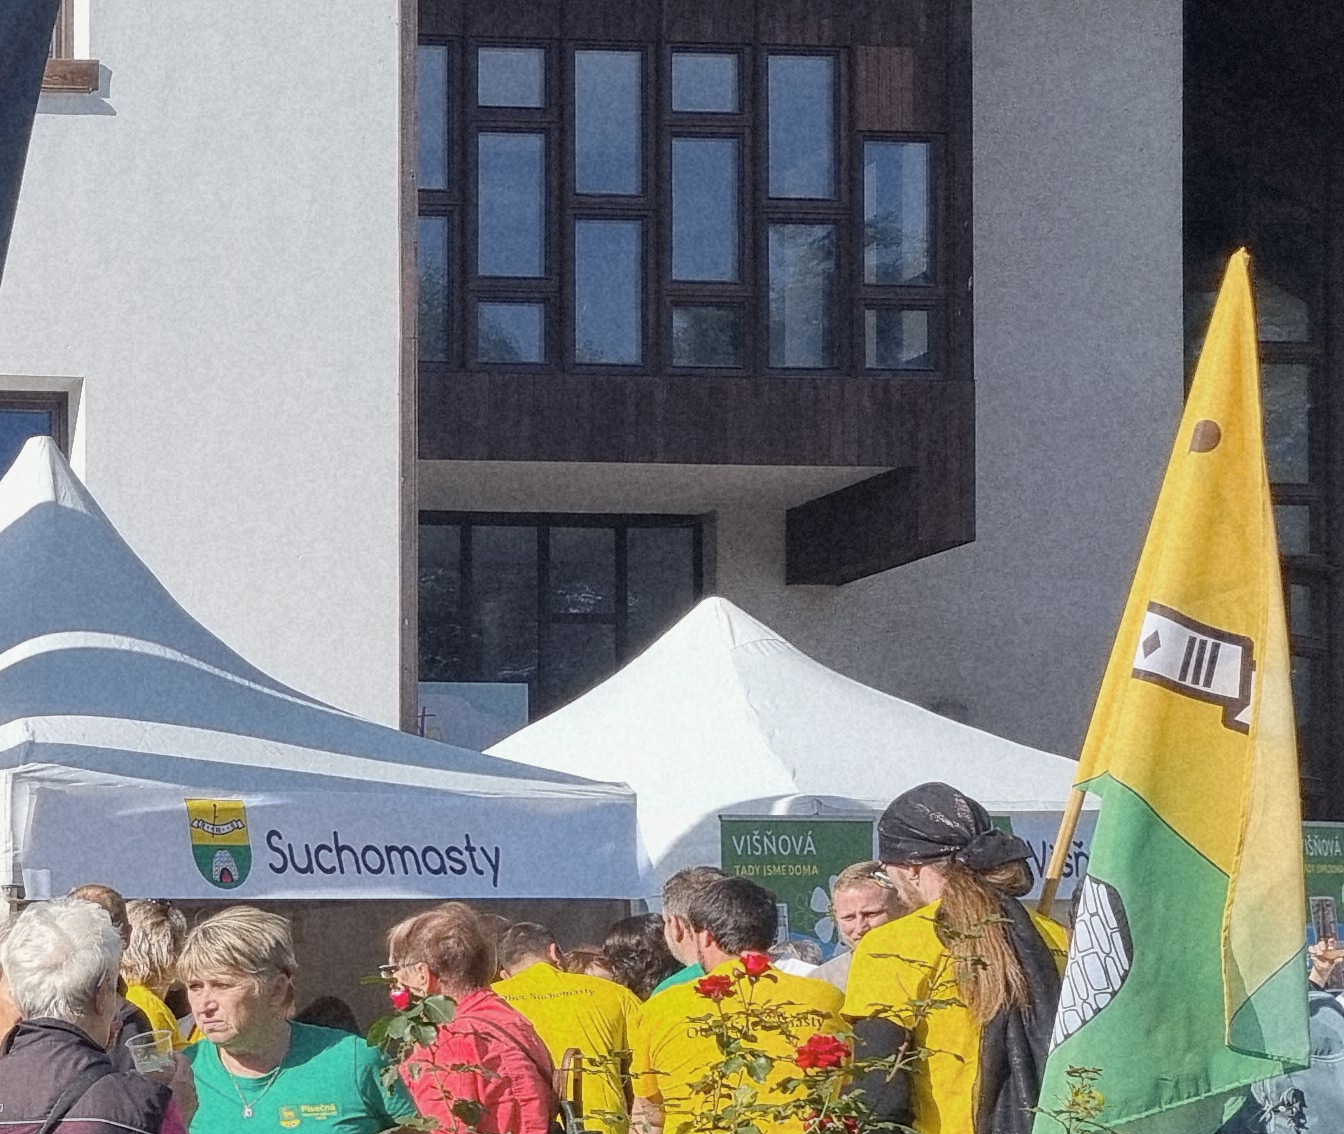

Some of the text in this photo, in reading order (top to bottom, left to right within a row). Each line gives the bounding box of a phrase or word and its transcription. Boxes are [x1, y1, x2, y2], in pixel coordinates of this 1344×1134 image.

[732, 830, 817, 856] VIŠŇOVÁ
[266, 829, 501, 887] Suchomasty
[734, 864, 760, 877] TADY
[788, 864, 819, 876] DOMA
